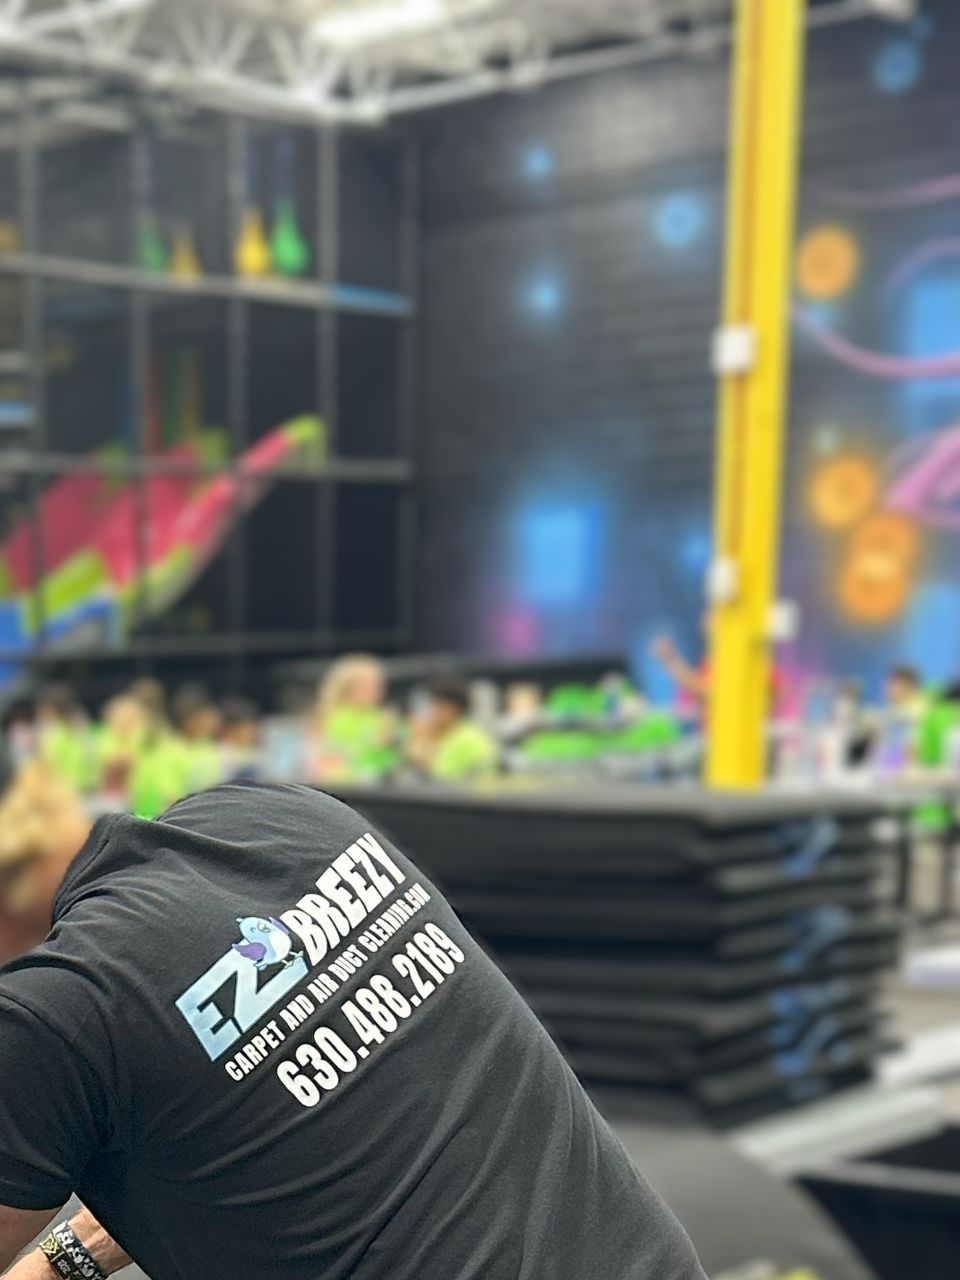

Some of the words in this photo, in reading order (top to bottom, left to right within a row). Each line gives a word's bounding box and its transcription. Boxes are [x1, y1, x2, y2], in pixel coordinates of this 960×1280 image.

[174, 934, 309, 1062] EZ
[279, 832, 406, 967] BREEZY
[224, 1019, 287, 1082] CARPET
[279, 994, 316, 1033] AND
[307, 973, 340, 1005] AIR
[327, 943, 369, 983] DUCT
[357, 882, 432, 953] CLEANING.COM
[276, 922, 465, 1108] 630.488.2189
